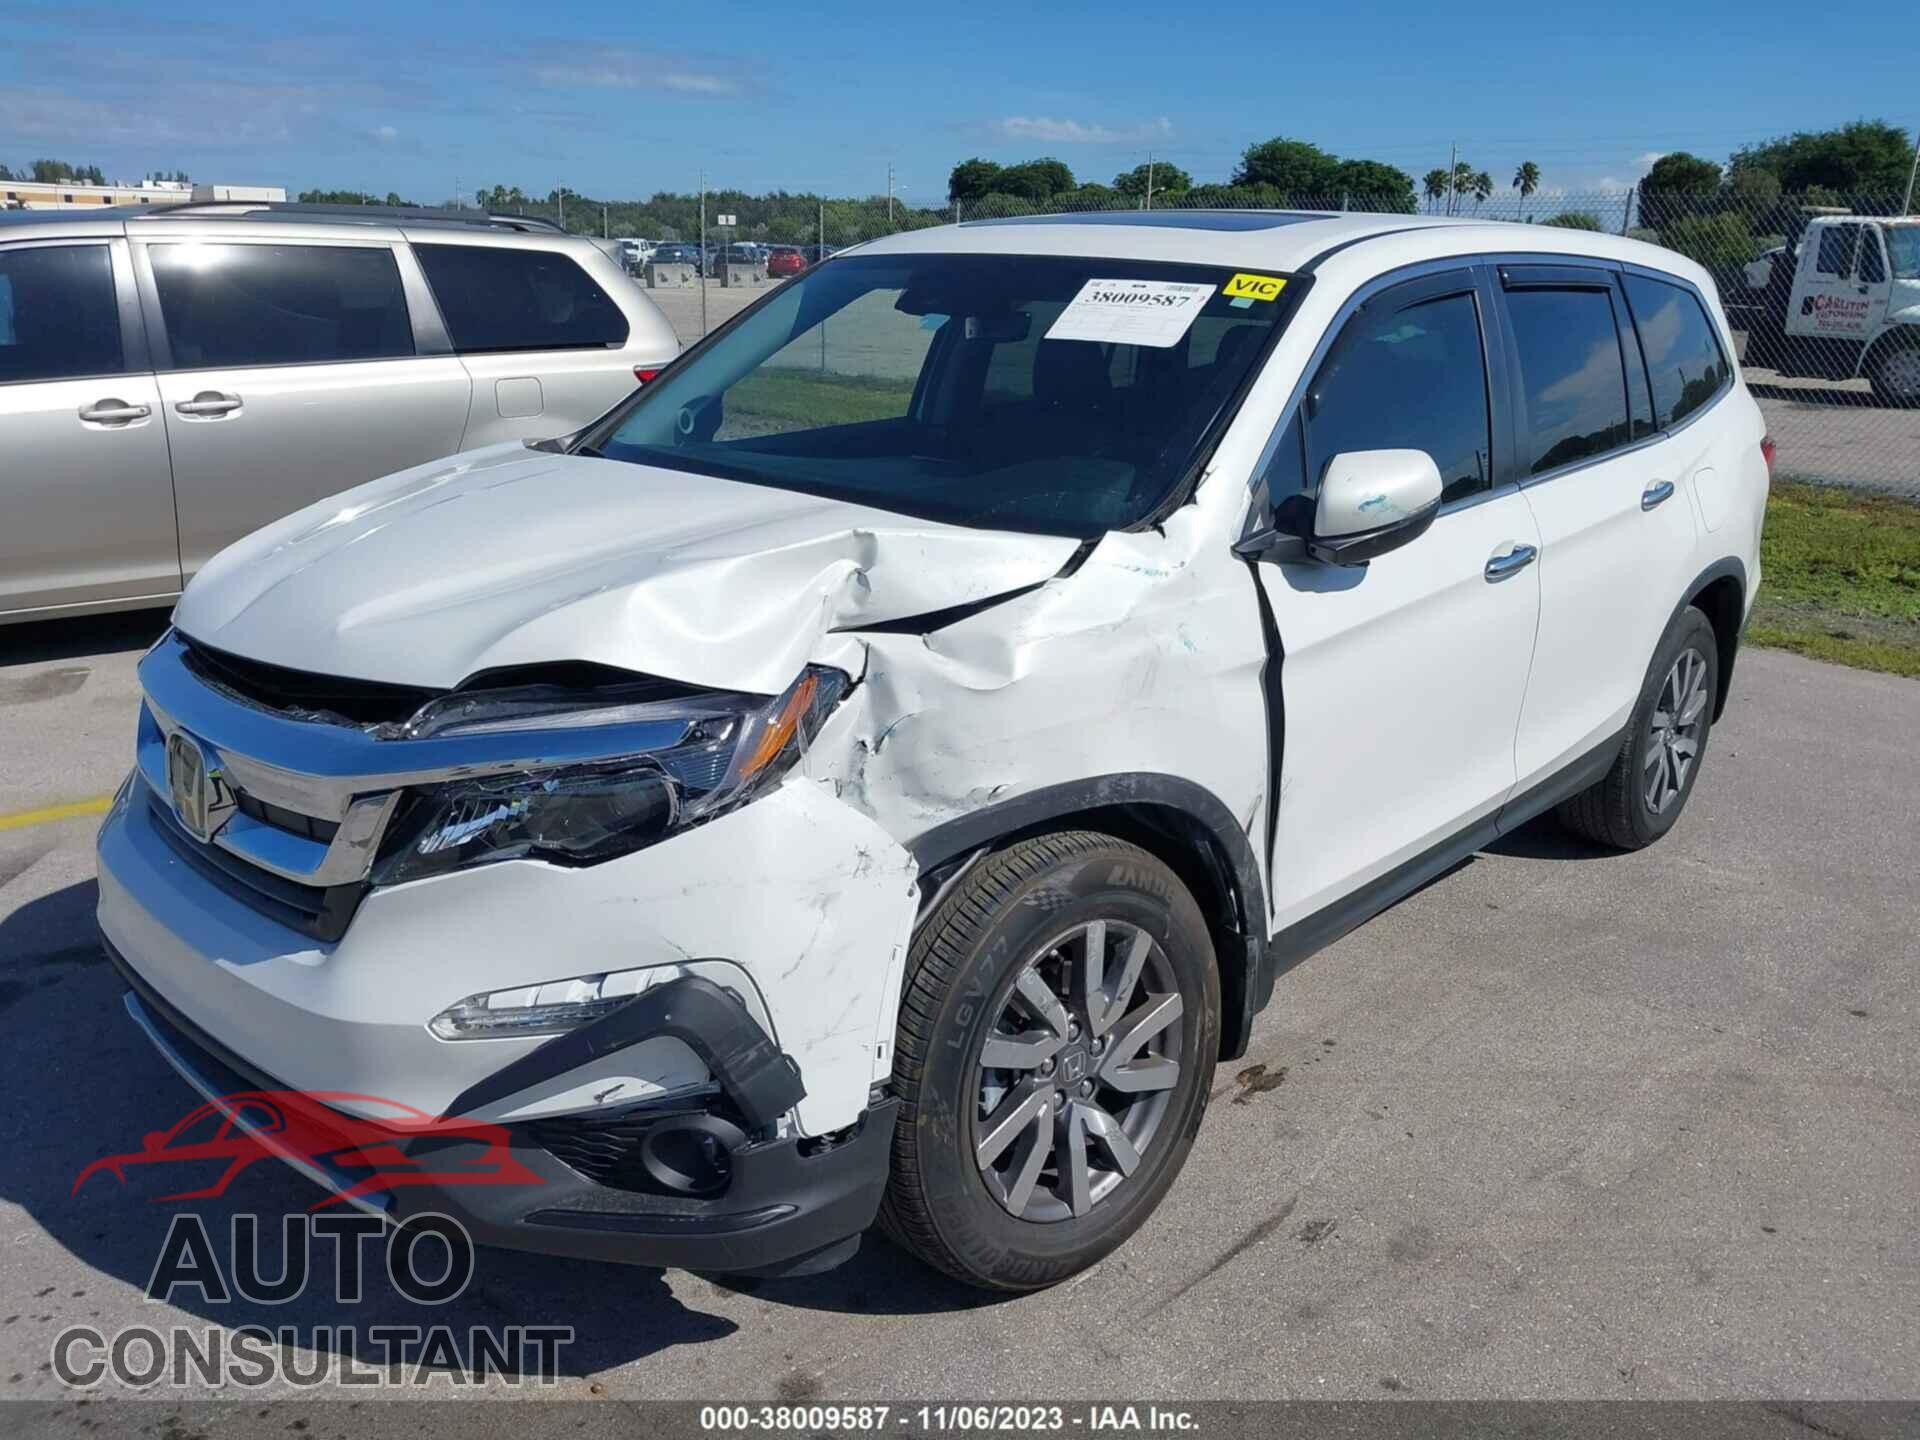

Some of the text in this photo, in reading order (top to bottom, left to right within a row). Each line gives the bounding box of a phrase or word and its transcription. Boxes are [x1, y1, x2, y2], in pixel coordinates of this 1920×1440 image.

[1234, 278, 1278, 295] VIC
[1085, 290, 1190, 308] 38009587
[945, 933, 1010, 1050] LGV77
